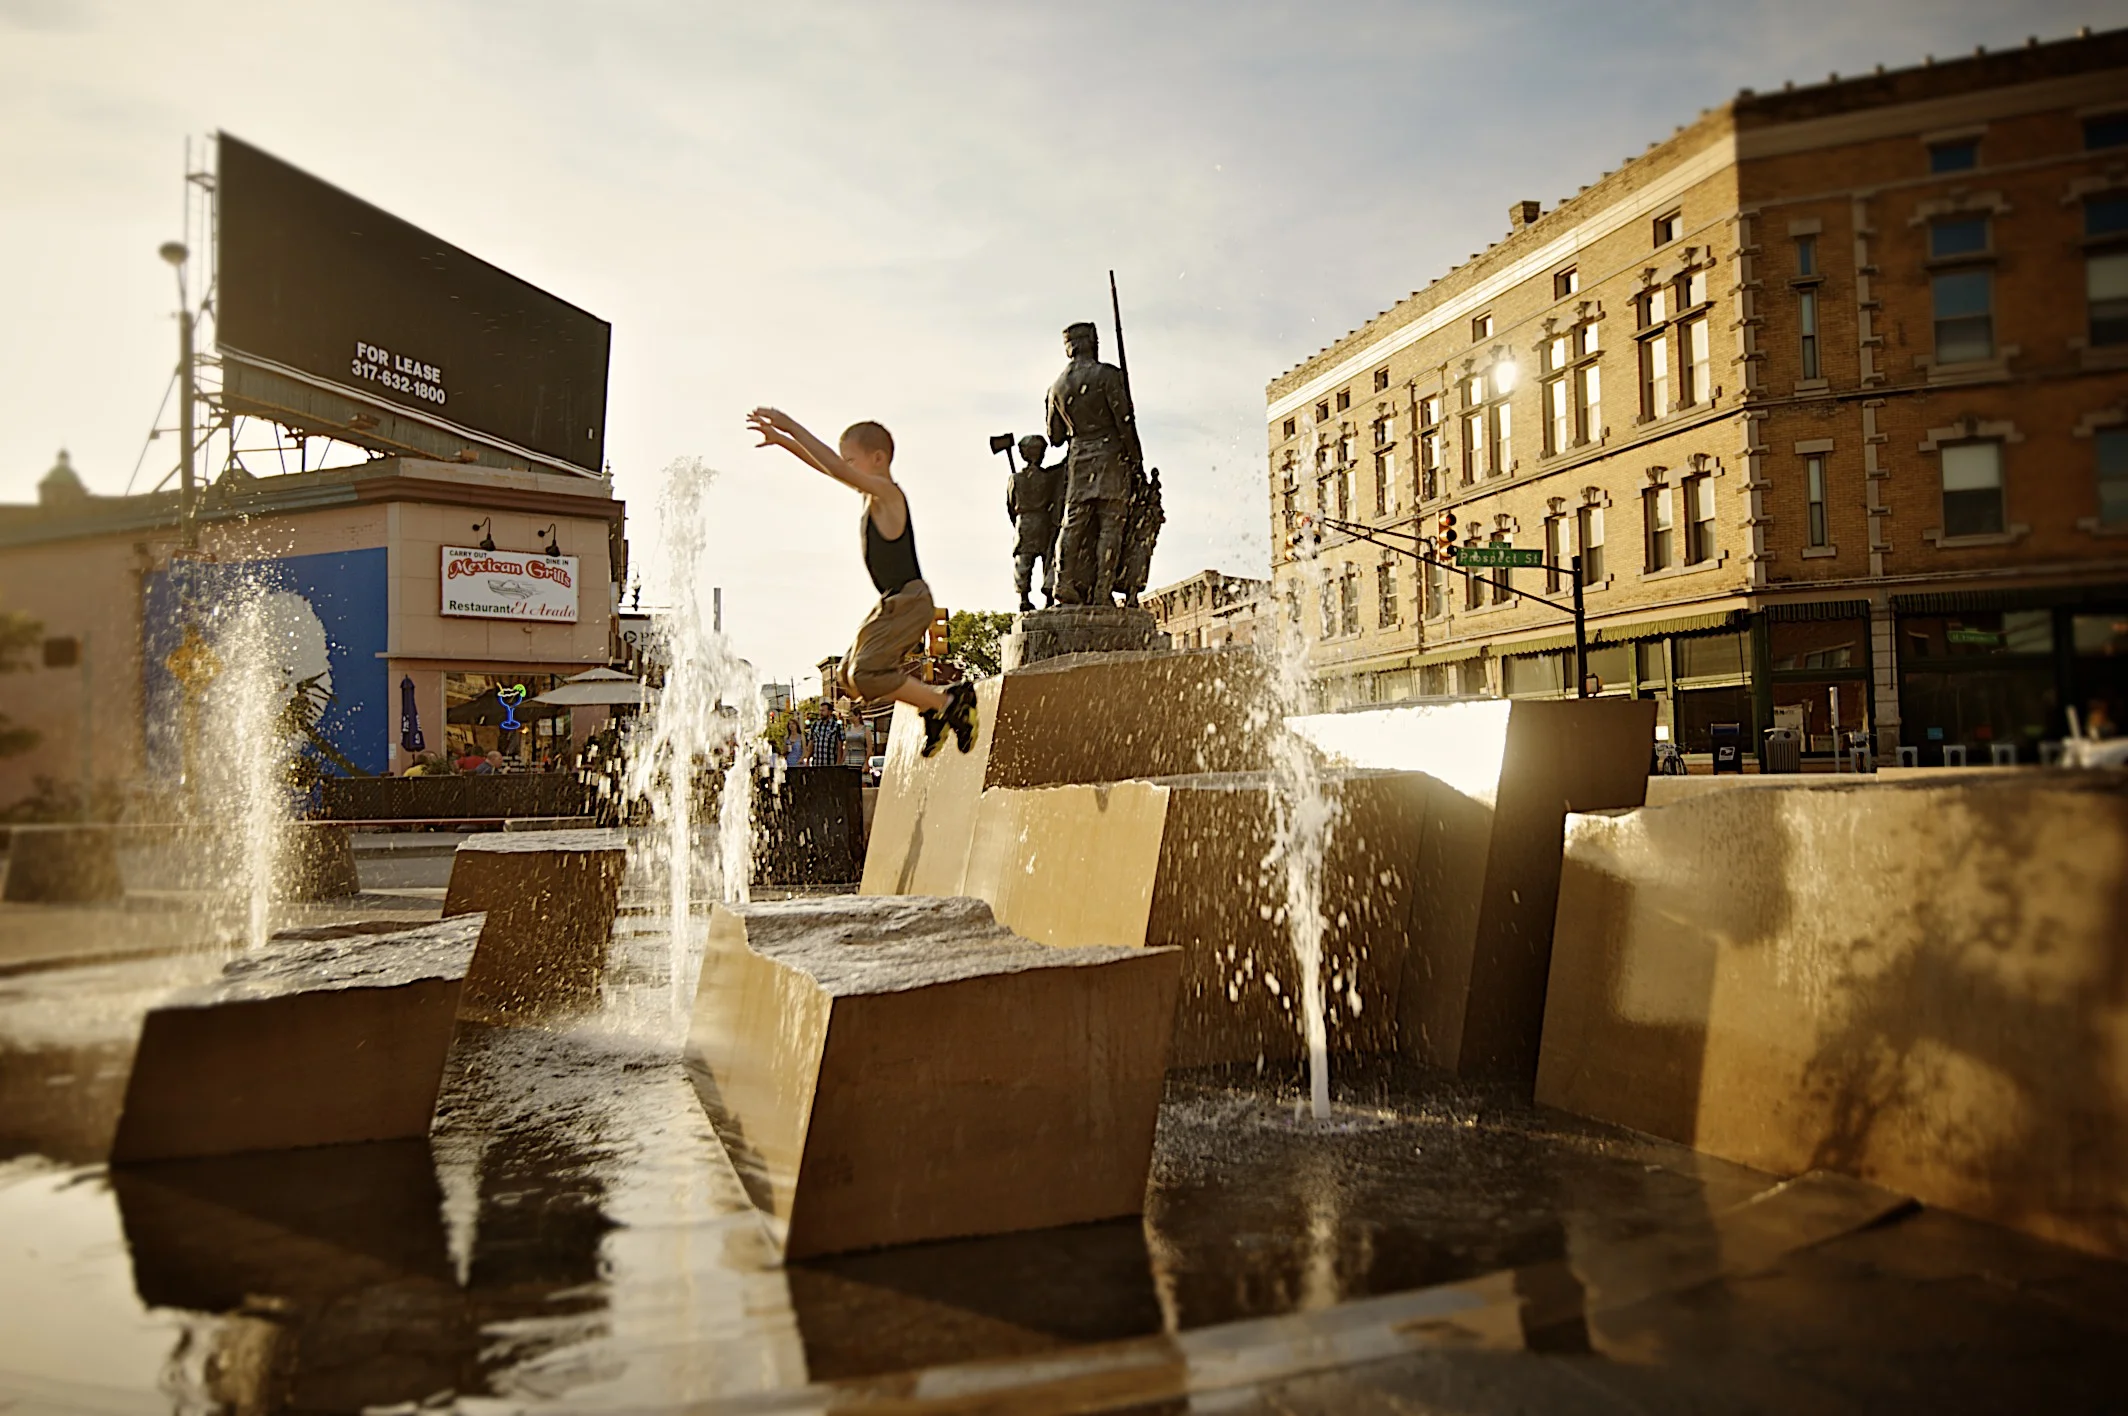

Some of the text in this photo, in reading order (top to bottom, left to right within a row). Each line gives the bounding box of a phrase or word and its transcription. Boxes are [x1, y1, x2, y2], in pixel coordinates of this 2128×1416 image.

[356, 341, 441, 384] FOR LEASE
[351, 359, 446, 405] 317-632-1800
[449, 549, 472, 558] CARRY
[1460, 552, 1538, 564] Prospect St
[448, 558, 571, 588] Mexican Grills
[449, 600, 576, 618] Restaurant El Arado
